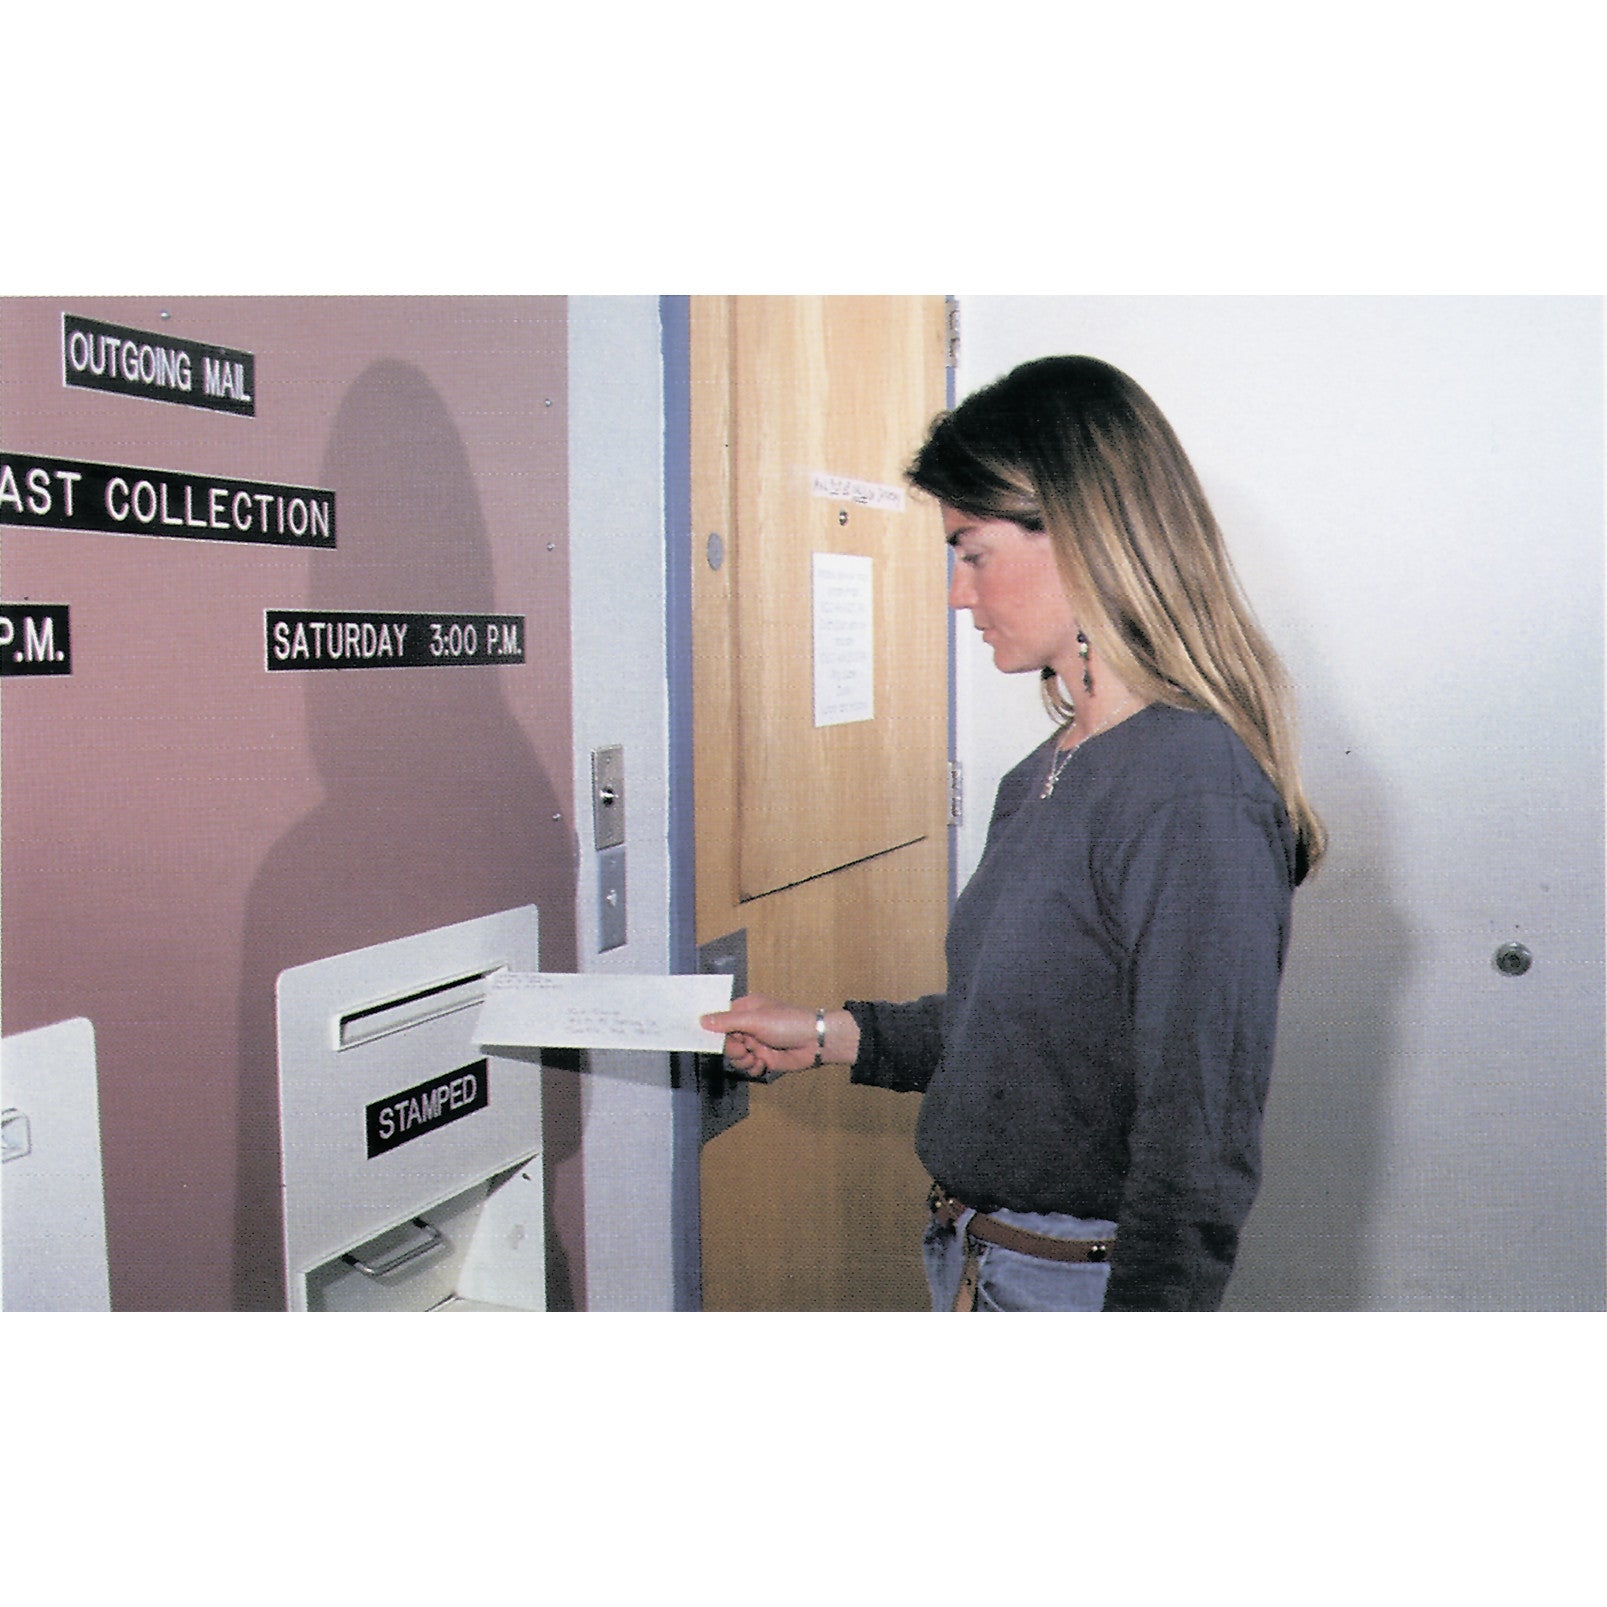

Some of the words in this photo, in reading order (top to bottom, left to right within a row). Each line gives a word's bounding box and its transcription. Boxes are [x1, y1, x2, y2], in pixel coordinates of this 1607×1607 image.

[69, 331, 192, 392] OUTGOING
[203, 356, 251, 402] MAIL
[0, 464, 82, 517] AST
[104, 477, 330, 538] COLLECTION
[0, 615, 65, 662] P.M.
[273, 621, 408, 660] SATURDAY
[429, 623, 478, 657] 3:00
[486, 624, 522, 655] P.M.
[378, 1073, 478, 1140] STAMPED
